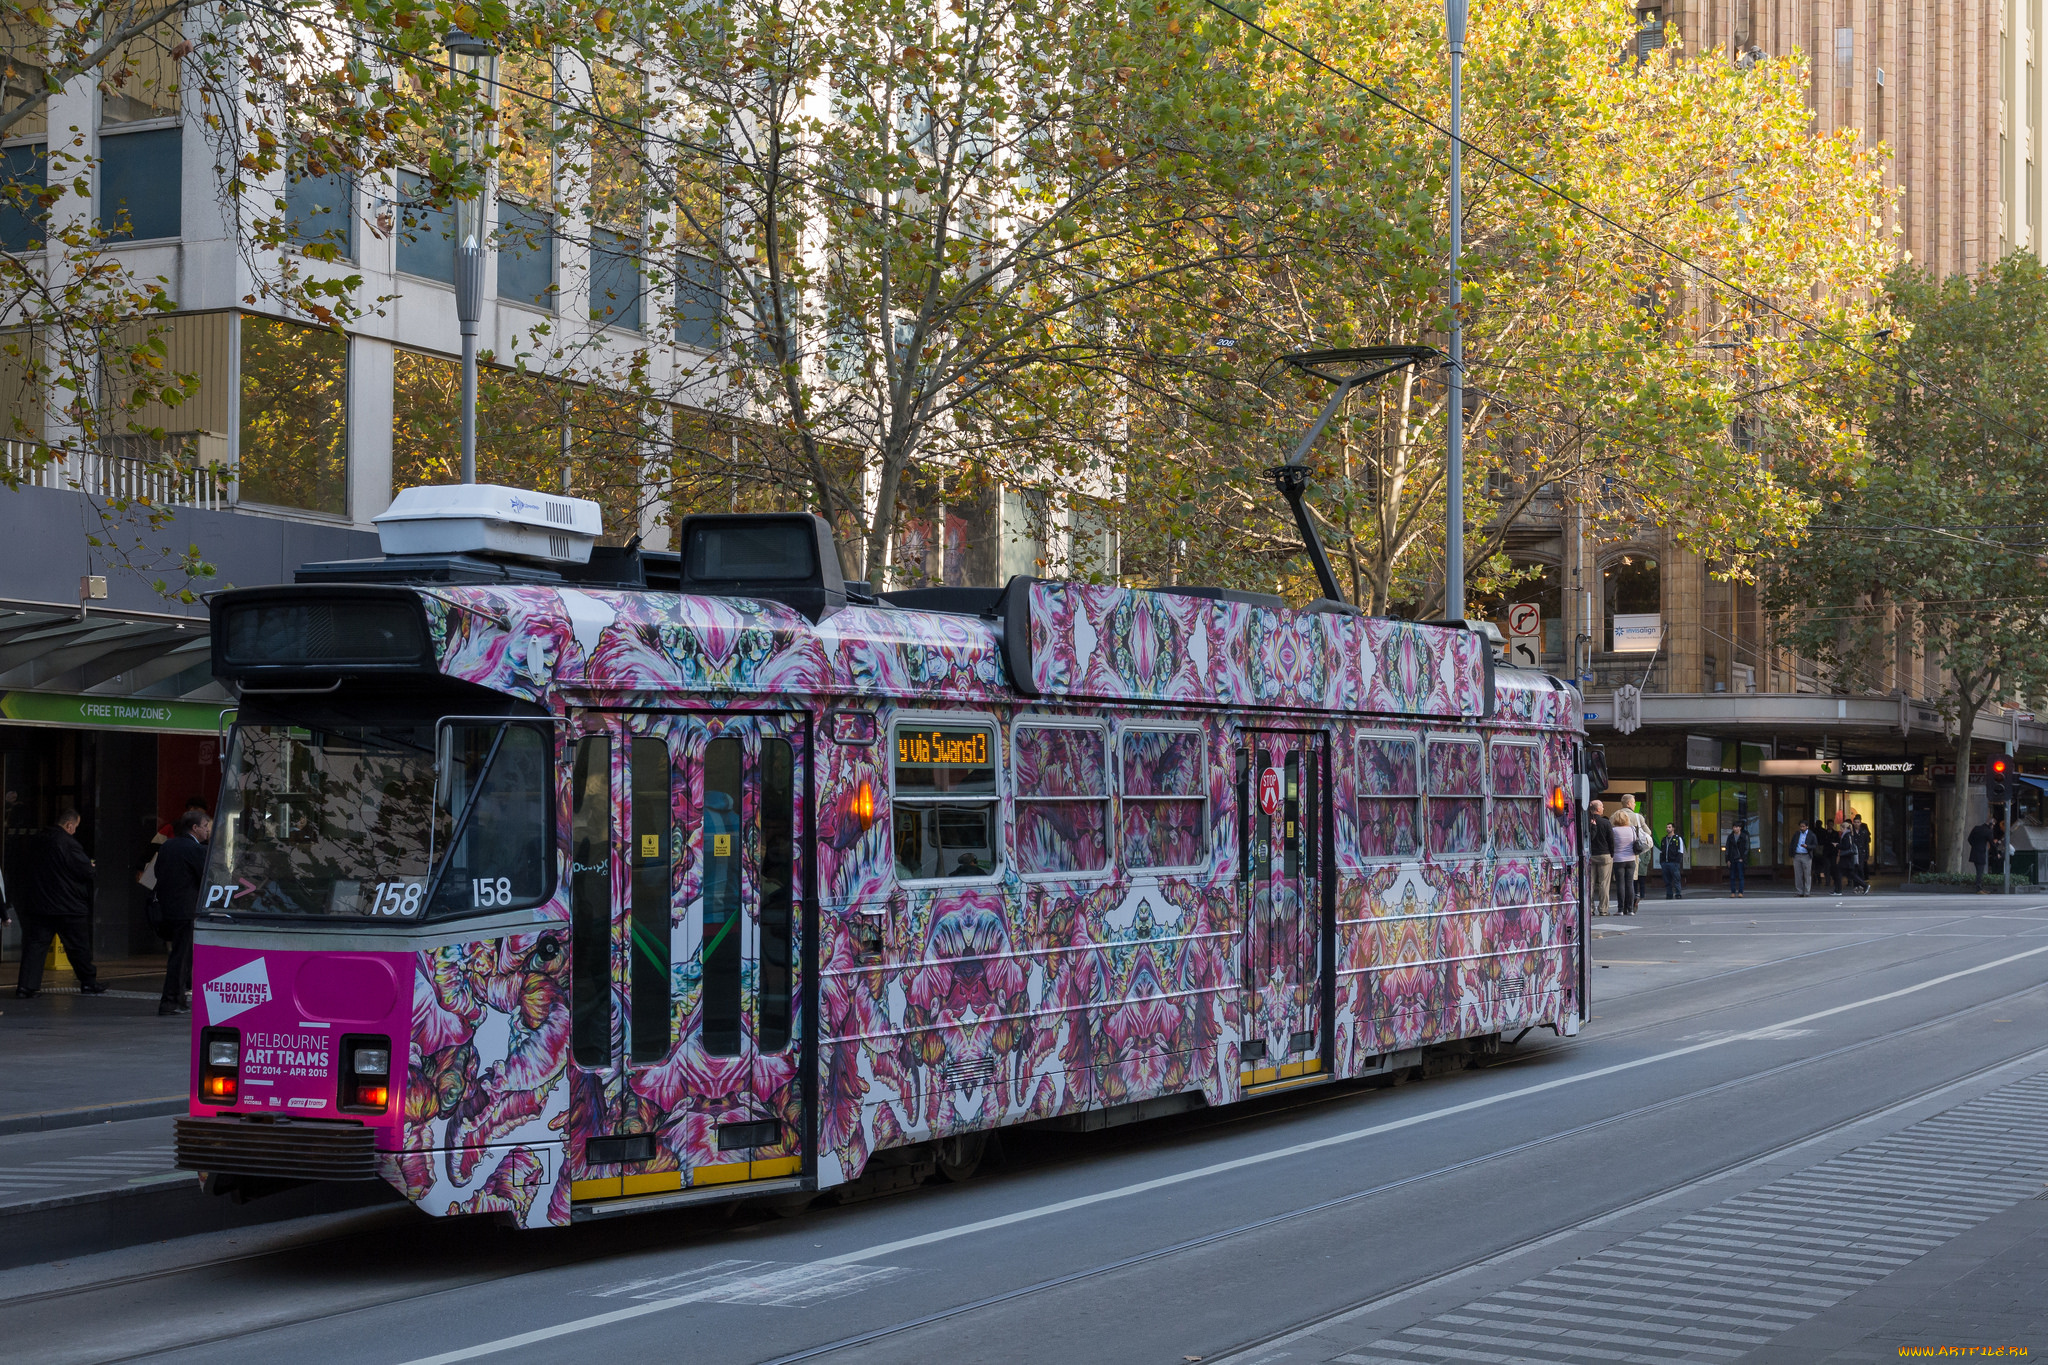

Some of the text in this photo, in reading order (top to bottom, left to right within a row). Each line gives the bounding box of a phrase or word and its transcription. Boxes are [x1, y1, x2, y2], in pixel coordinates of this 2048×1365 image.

[87, 704, 165, 720] FREE TRAM ZONE
[899, 738, 908, 762] y
[910, 733, 930, 762] via
[1875, 763, 1903, 771] MONEY
[1262, 774, 1276, 787] STOP
[371, 882, 422, 916] 158
[472, 877, 512, 907] 158
[205, 981, 268, 994] MELBOURNE
[219, 993, 267, 1004] FESTIVAL
[246, 1032, 329, 1050] MELBOURNE
[245, 1049, 329, 1067] ART TRAMS
[245, 1065, 261, 1074] OCT
[262, 1066, 281, 1075] 2014
[289, 1068, 306, 1076] APR
[308, 1068, 328, 1077] 2015
